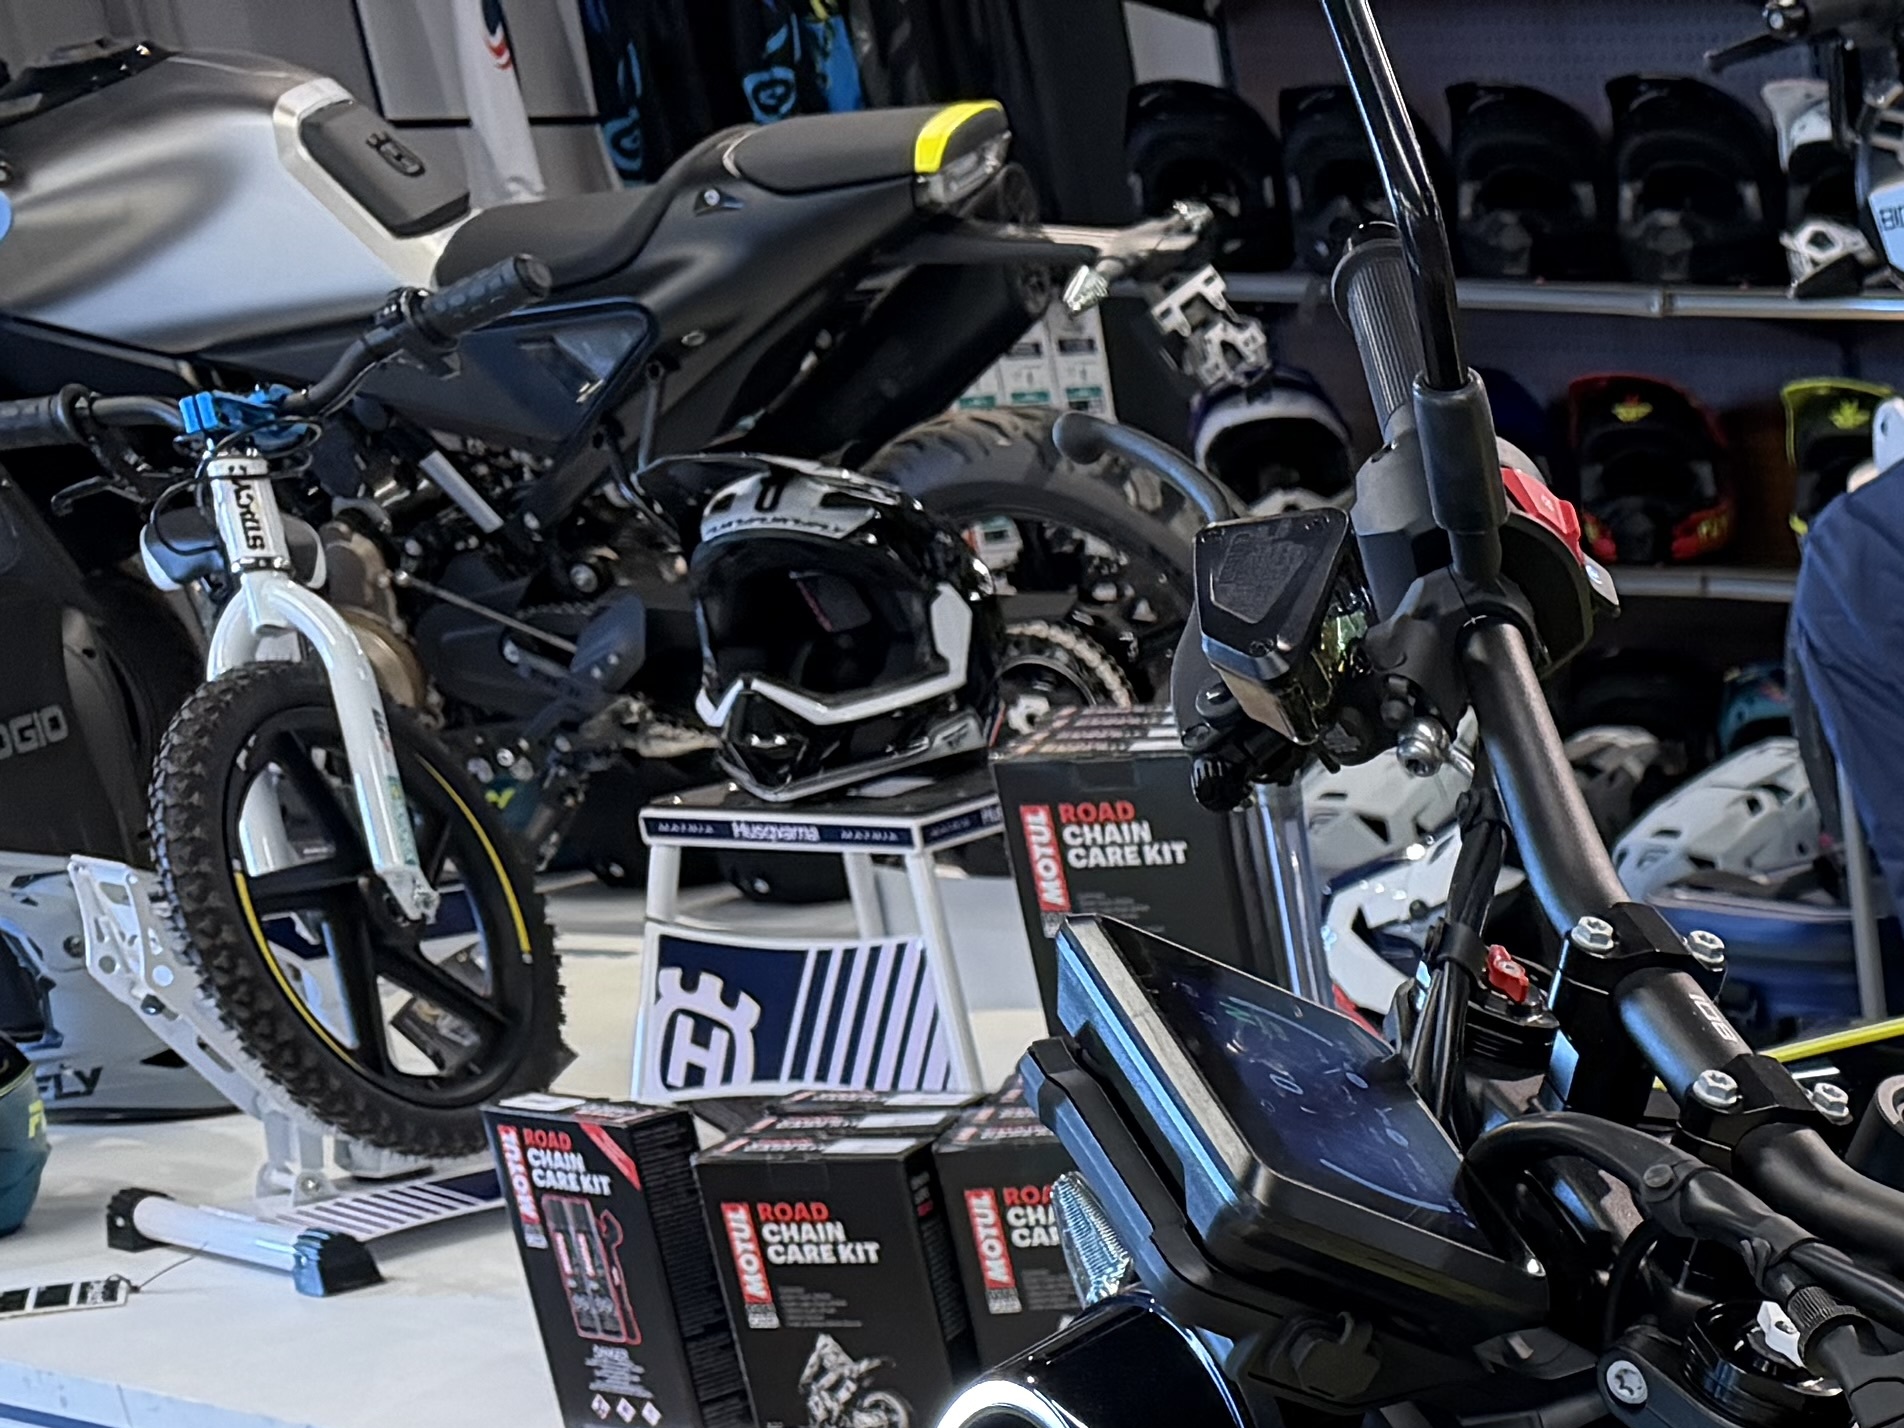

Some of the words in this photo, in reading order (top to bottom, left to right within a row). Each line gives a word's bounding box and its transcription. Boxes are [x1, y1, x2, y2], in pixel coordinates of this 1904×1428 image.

[1058, 800, 1136, 824] ROAD
[1062, 820, 1152, 846] CHAIN
[1024, 811, 1065, 906] MOTUL
[1067, 845, 1142, 870] CARE
[1142, 840, 1188, 866] KIT
[523, 1127, 572, 1151] ROAD
[526, 1147, 586, 1173] CHAIN
[502, 1131, 540, 1222] MOTUL
[531, 1168, 581, 1193] CARE
[580, 1173, 612, 1197] KIT
[756, 1201, 830, 1222] ROAD
[761, 1220, 847, 1244] CHAIN
[971, 1194, 1011, 1283] MOTUL
[725, 1210, 768, 1299] MOTUL
[766, 1243, 838, 1265] CARE
[839, 1240, 881, 1264] KIT
